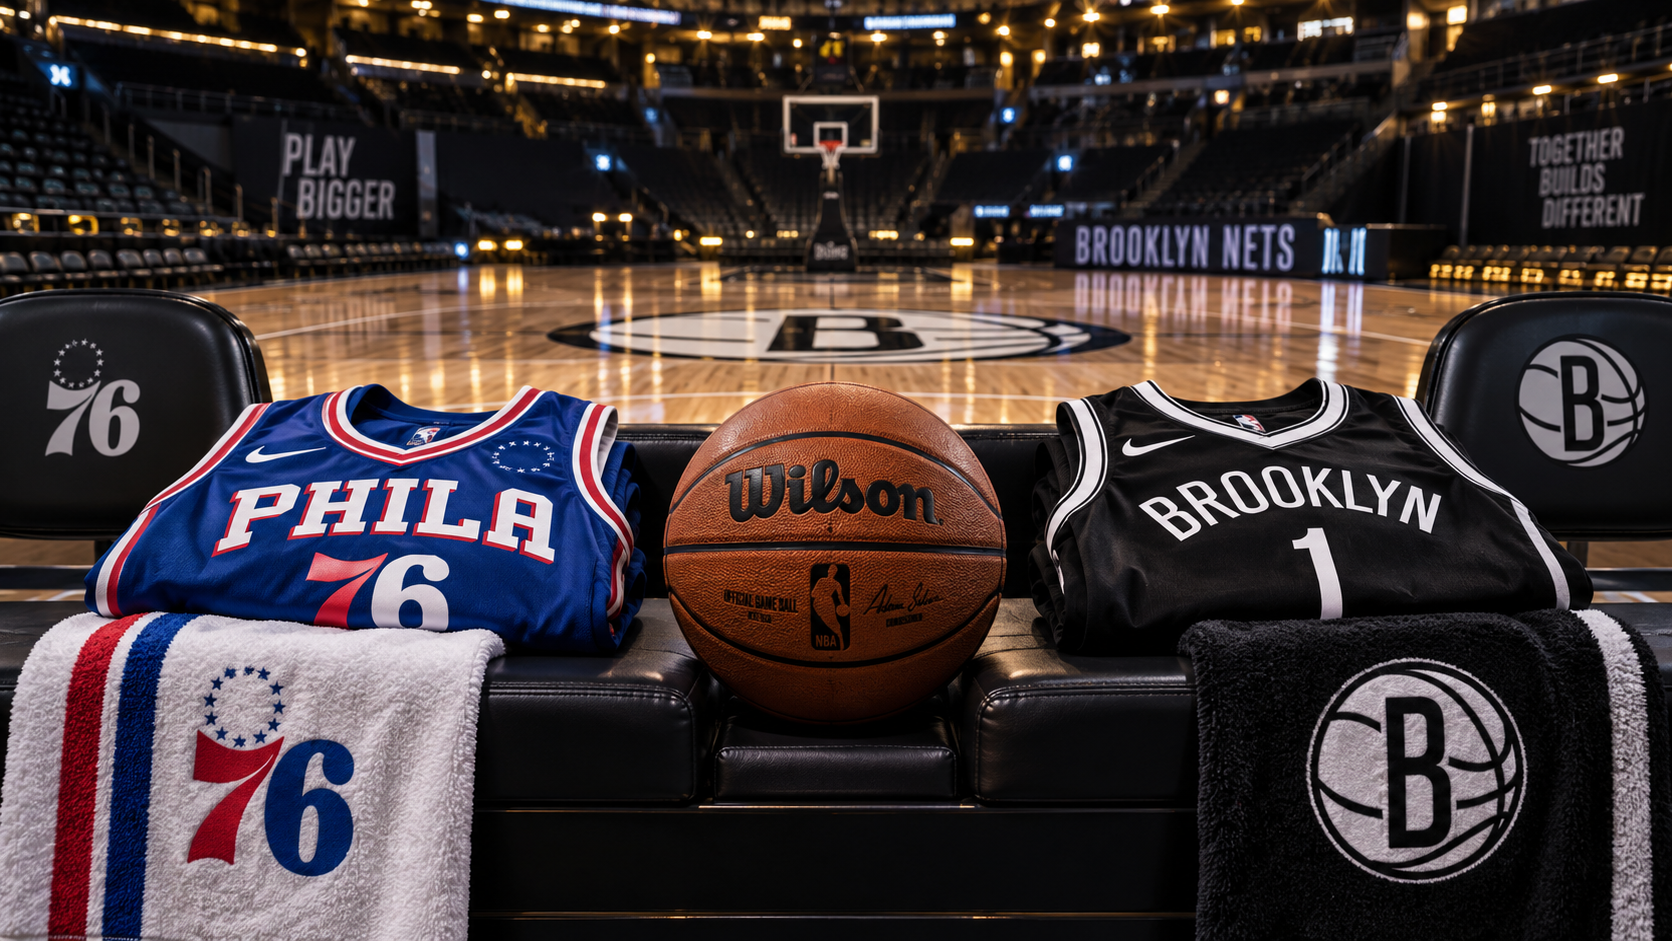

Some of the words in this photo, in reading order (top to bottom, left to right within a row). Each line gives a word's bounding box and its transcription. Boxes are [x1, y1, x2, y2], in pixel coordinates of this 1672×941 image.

[283, 132, 356, 178] PLAY
[1528, 126, 1624, 167] TOGETHER
[1538, 162, 1606, 197] BUILDS
[296, 178, 396, 220] BIGGER
[1541, 192, 1645, 229] DIFFERENT
[1074, 224, 1210, 269] BROOKLYN
[1221, 223, 1295, 272] NETS
[766, 315, 926, 352] B
[45, 379, 141, 457] 76
[1560, 355, 1605, 452] B
[211, 478, 556, 565] PHILA
[725, 459, 941, 526] Wilson
[1138, 465, 1442, 542] BROOKLYN
[305, 552, 450, 632] 76
[1292, 527, 1343, 620] 1
[815, 635, 837, 648] NBA
[187, 729, 355, 877] 76
[1385, 696, 1452, 849] B
